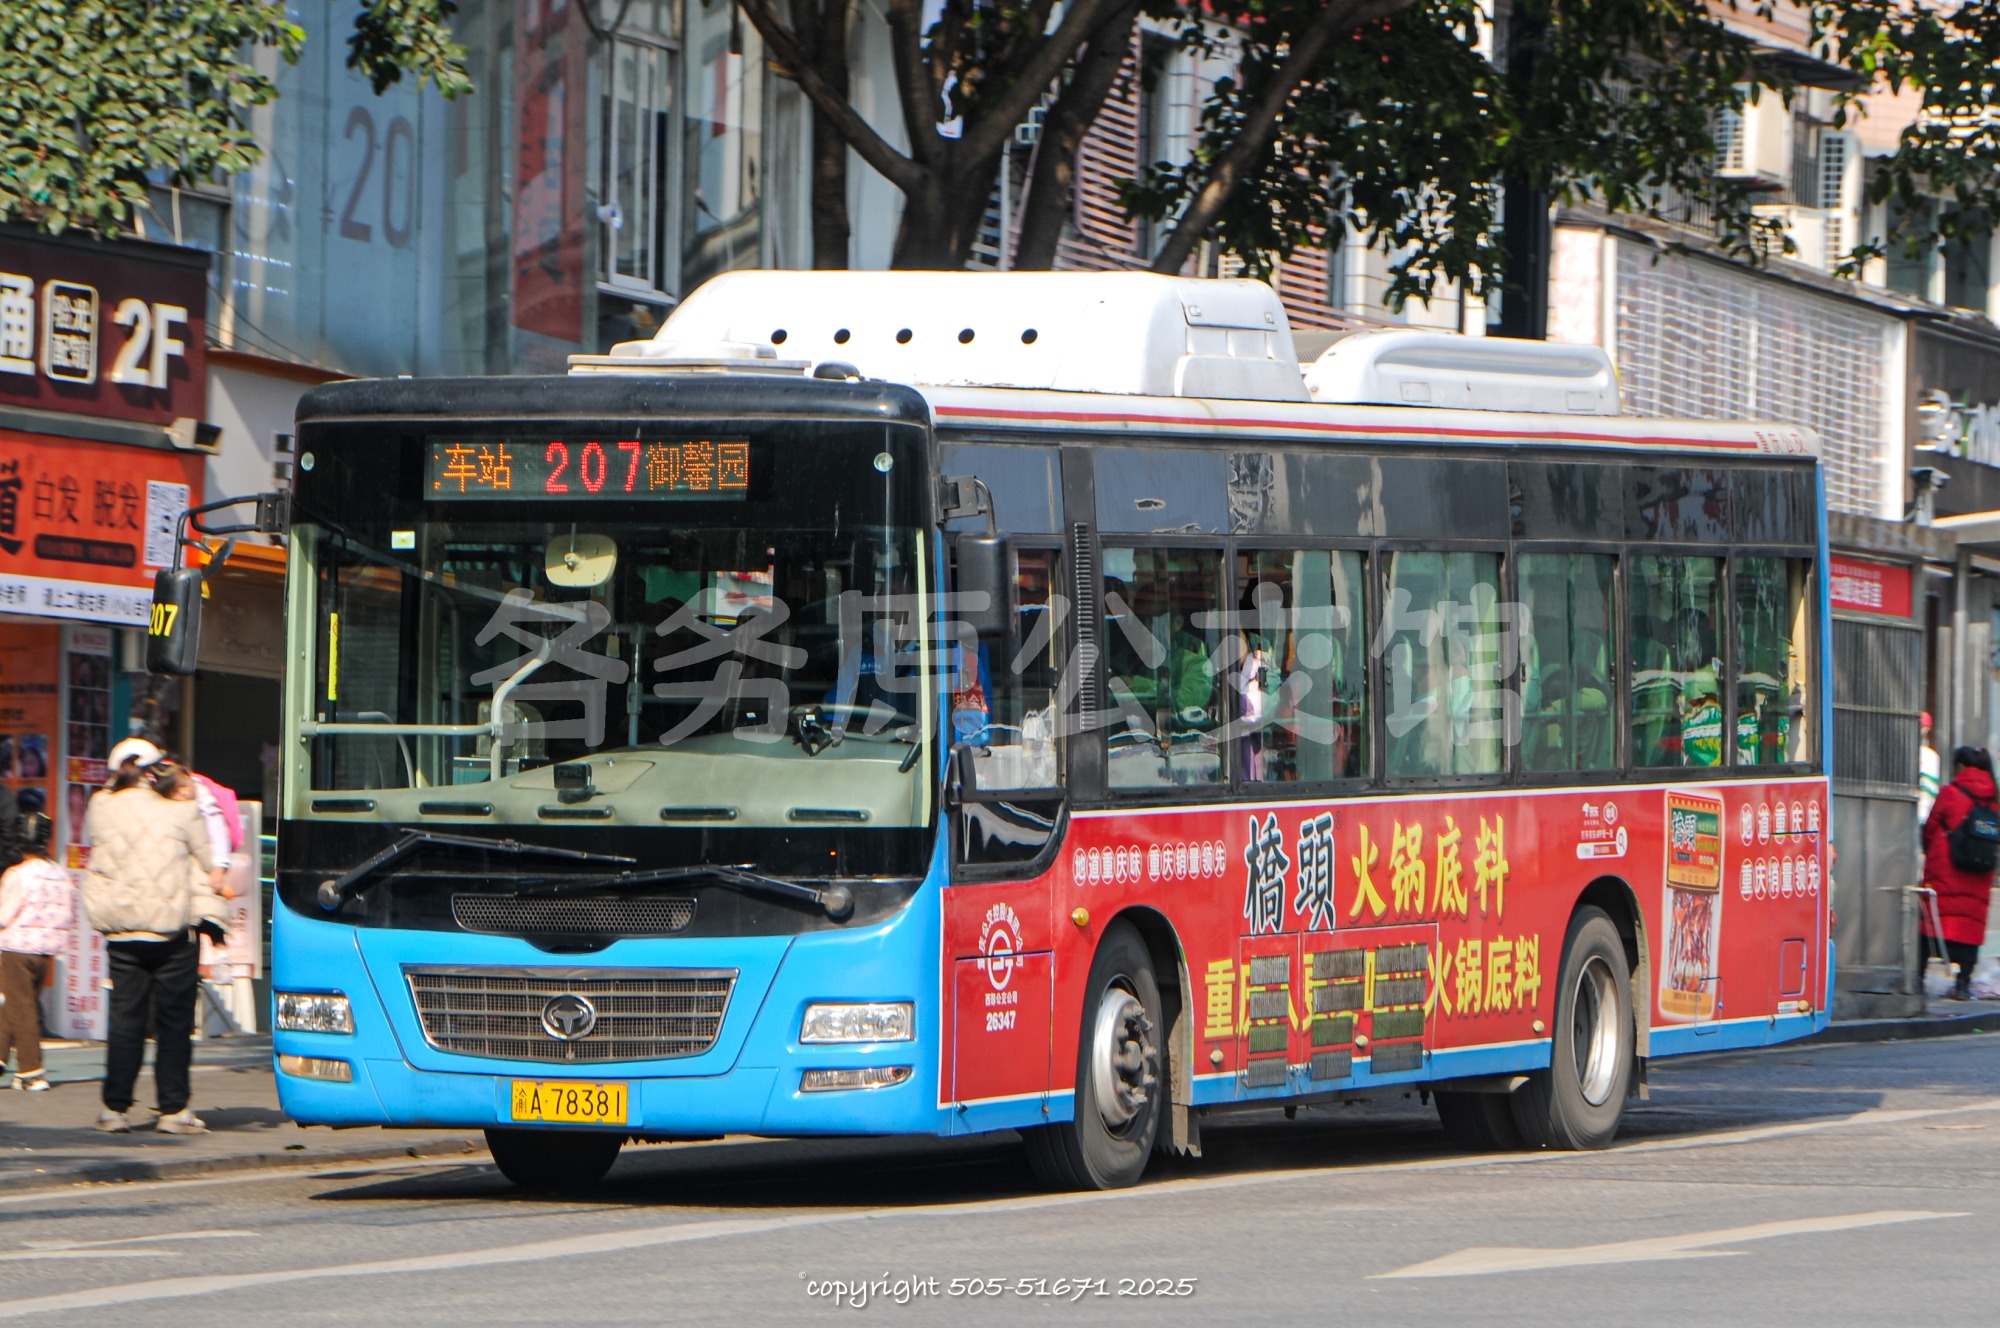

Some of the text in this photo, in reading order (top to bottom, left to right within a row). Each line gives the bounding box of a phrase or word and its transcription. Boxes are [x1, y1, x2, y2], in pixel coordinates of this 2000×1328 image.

[339, 106, 414, 248] 20
[111, 297, 188, 389] 2F
[546, 441, 641, 493] 207
[646, 441, 749, 492] 御馨园
[1742, 802, 1819, 843] 地道重庆味
[1074, 841, 1226, 886] 地道重庆味 重庆销量领先
[1244, 811, 1510, 938] 橋頭 火锅底料
[1742, 857, 1819, 899] 重庆销量领先
[986, 1010, 1016, 1031] 26347
